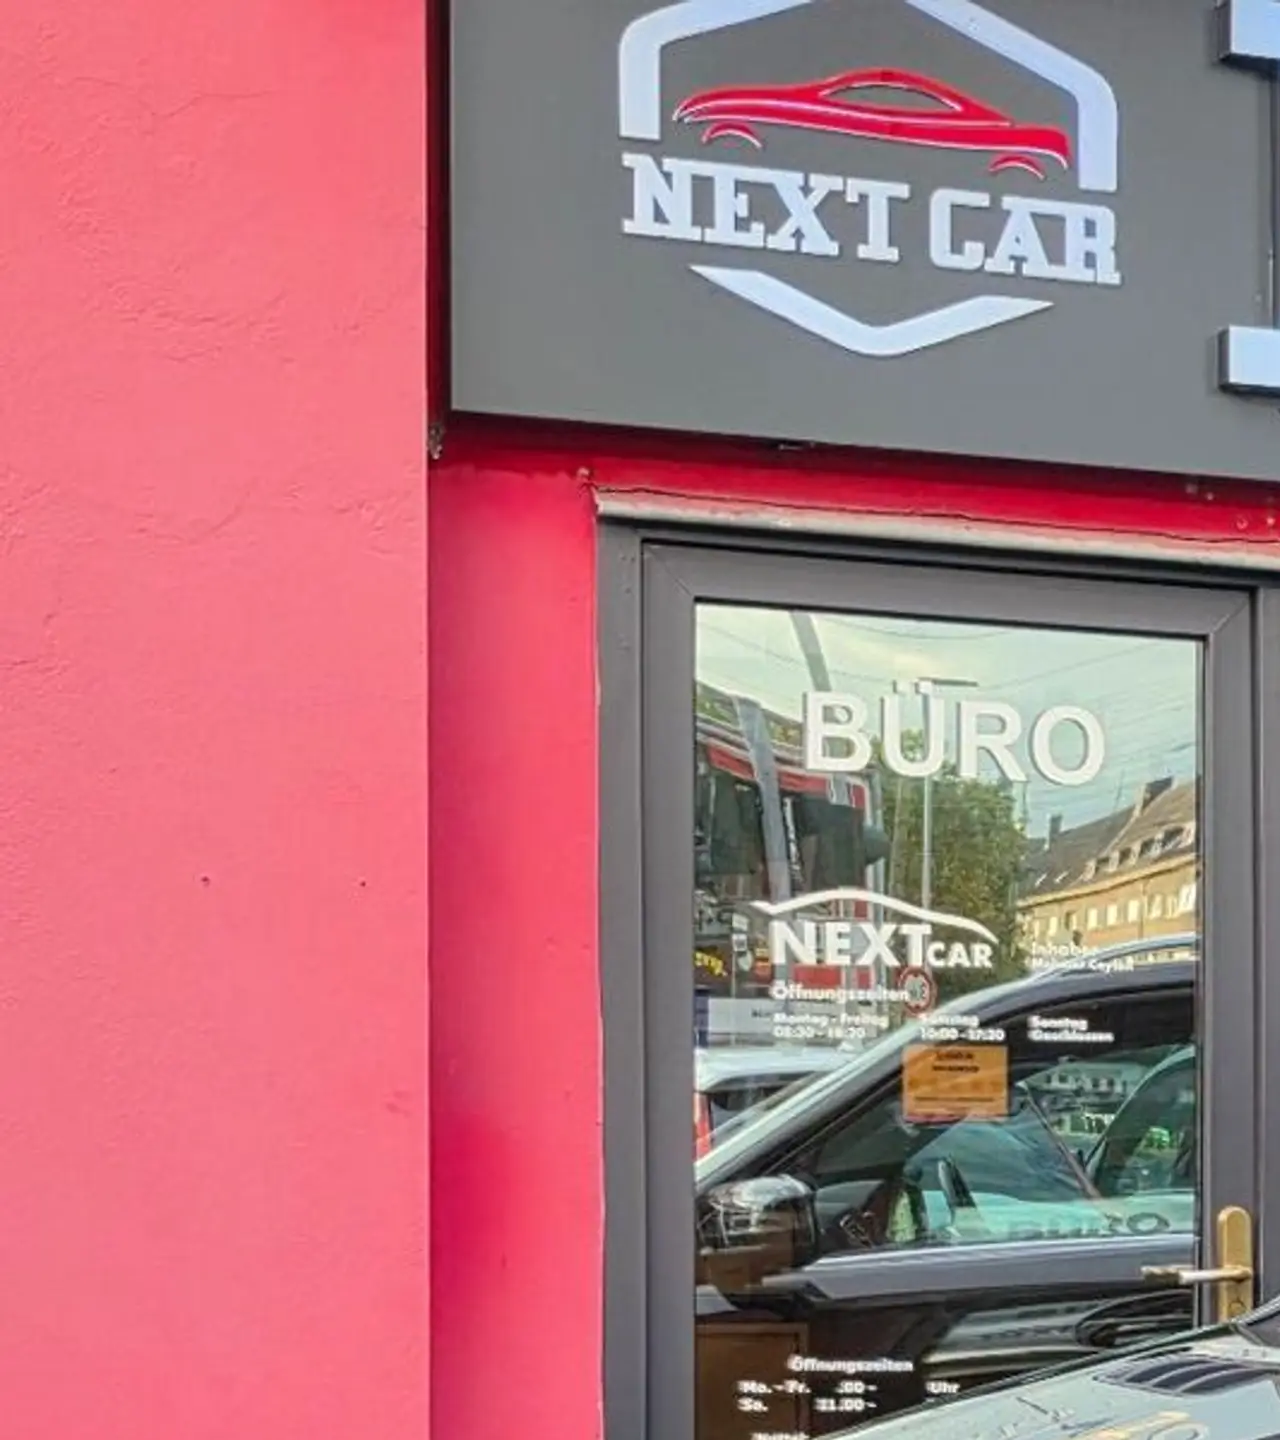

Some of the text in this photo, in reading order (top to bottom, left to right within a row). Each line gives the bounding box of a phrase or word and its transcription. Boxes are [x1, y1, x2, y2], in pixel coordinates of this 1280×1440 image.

[621, 152, 1121, 285] NEXT CAR
[801, 679, 1106, 787] BÜRO
[768, 978, 909, 1004] Öffnungszeiten
[788, 1354, 914, 1374] Öffnungszeiten
